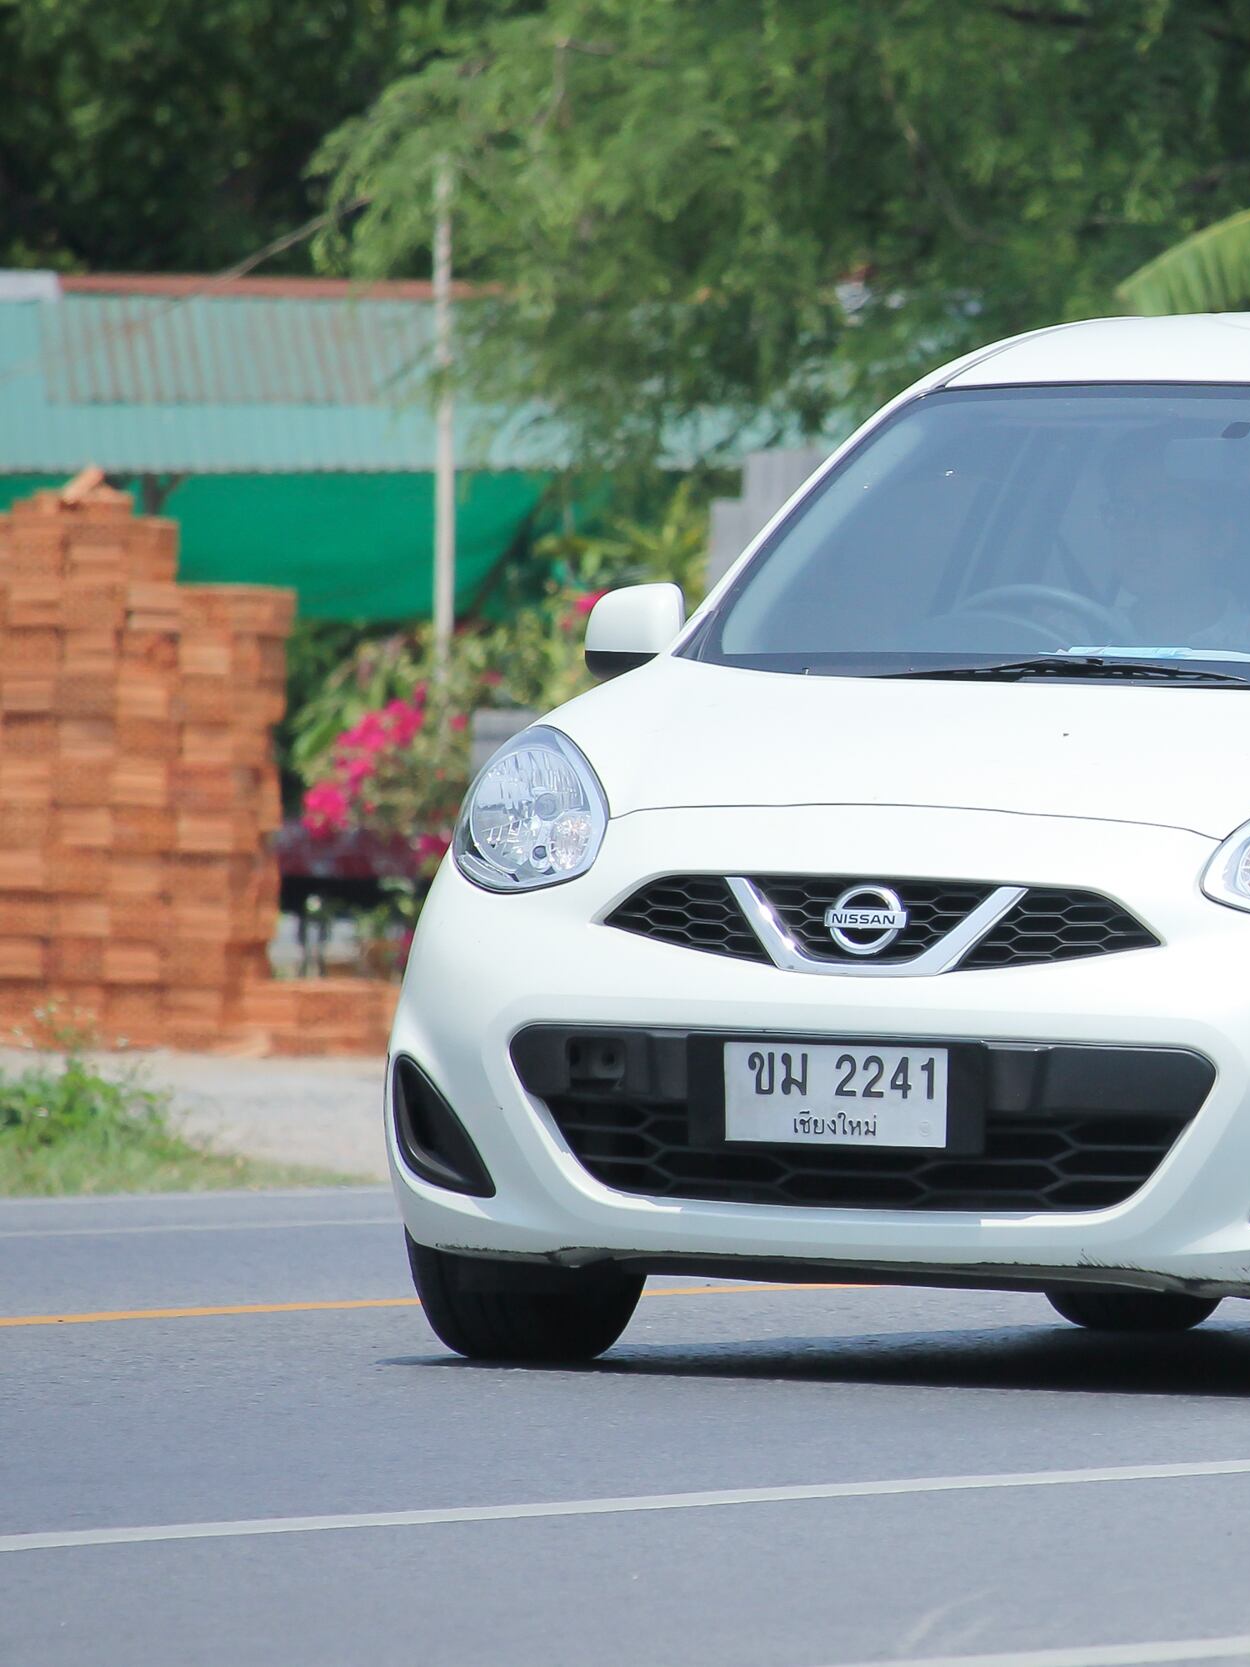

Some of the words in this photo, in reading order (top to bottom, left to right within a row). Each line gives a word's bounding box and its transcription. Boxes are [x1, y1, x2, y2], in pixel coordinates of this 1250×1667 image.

[832, 913, 895, 925] NISSAN
[748, 1052, 808, 1095] ขม
[835, 1054, 935, 1100] 2241
[793, 1110, 878, 1136] เชียงใหม่
